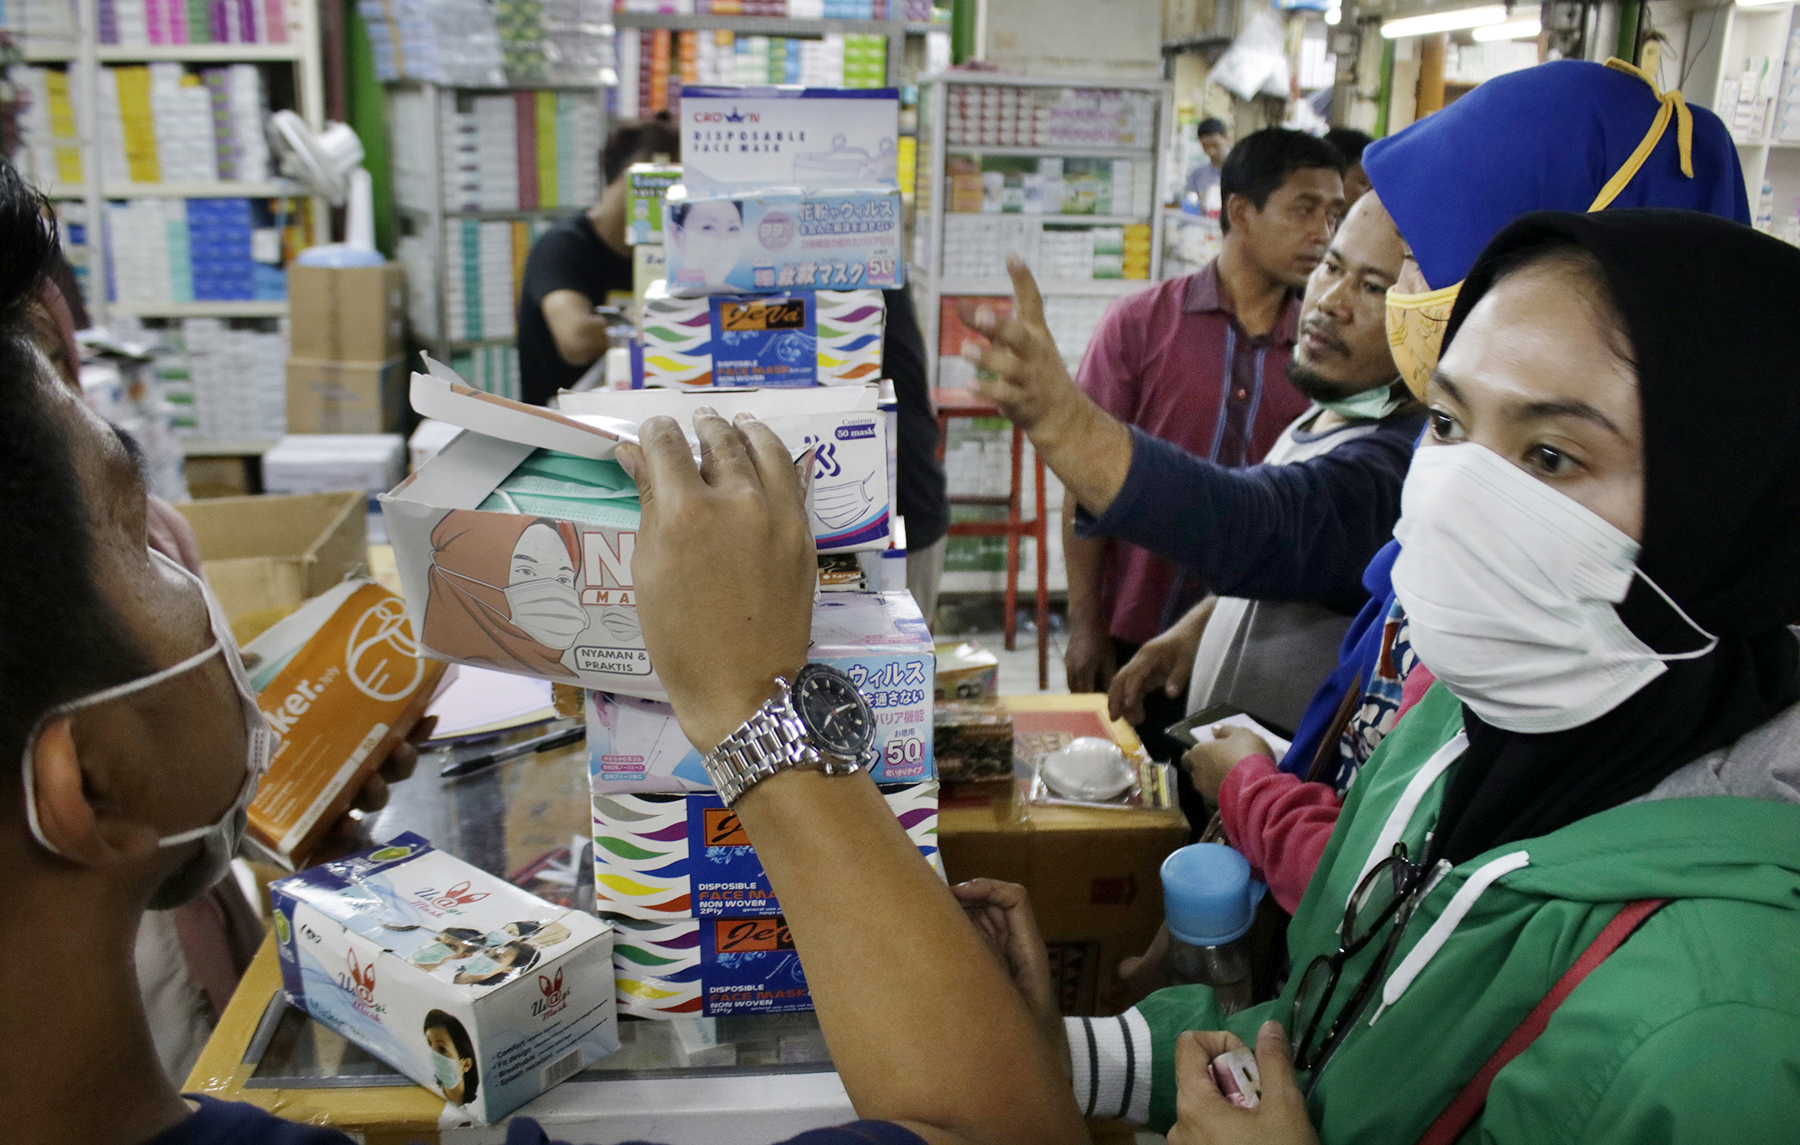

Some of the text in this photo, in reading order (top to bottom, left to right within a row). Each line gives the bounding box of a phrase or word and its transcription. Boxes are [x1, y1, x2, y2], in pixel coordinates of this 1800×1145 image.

[694, 131, 805, 141] DISPOSABLE
[694, 144, 780, 153] FACE MASK
[837, 427, 875, 438] 50 mask
[581, 649, 647, 661] NYAMAN &
[585, 660, 633, 672] PRAKTIS
[887, 738, 922, 765] 50
[698, 882, 757, 891] DISPOSIBLE
[699, 890, 745, 900] FACE
[699, 900, 723, 909] NON
[725, 899, 767, 909] WOVEN
[700, 907, 724, 916] 2Ply
[709, 983, 765, 994] DISPOSIBLE
[710, 989, 808, 1002] FACE MASK
[710, 999, 773, 1009] NON WOVEN
